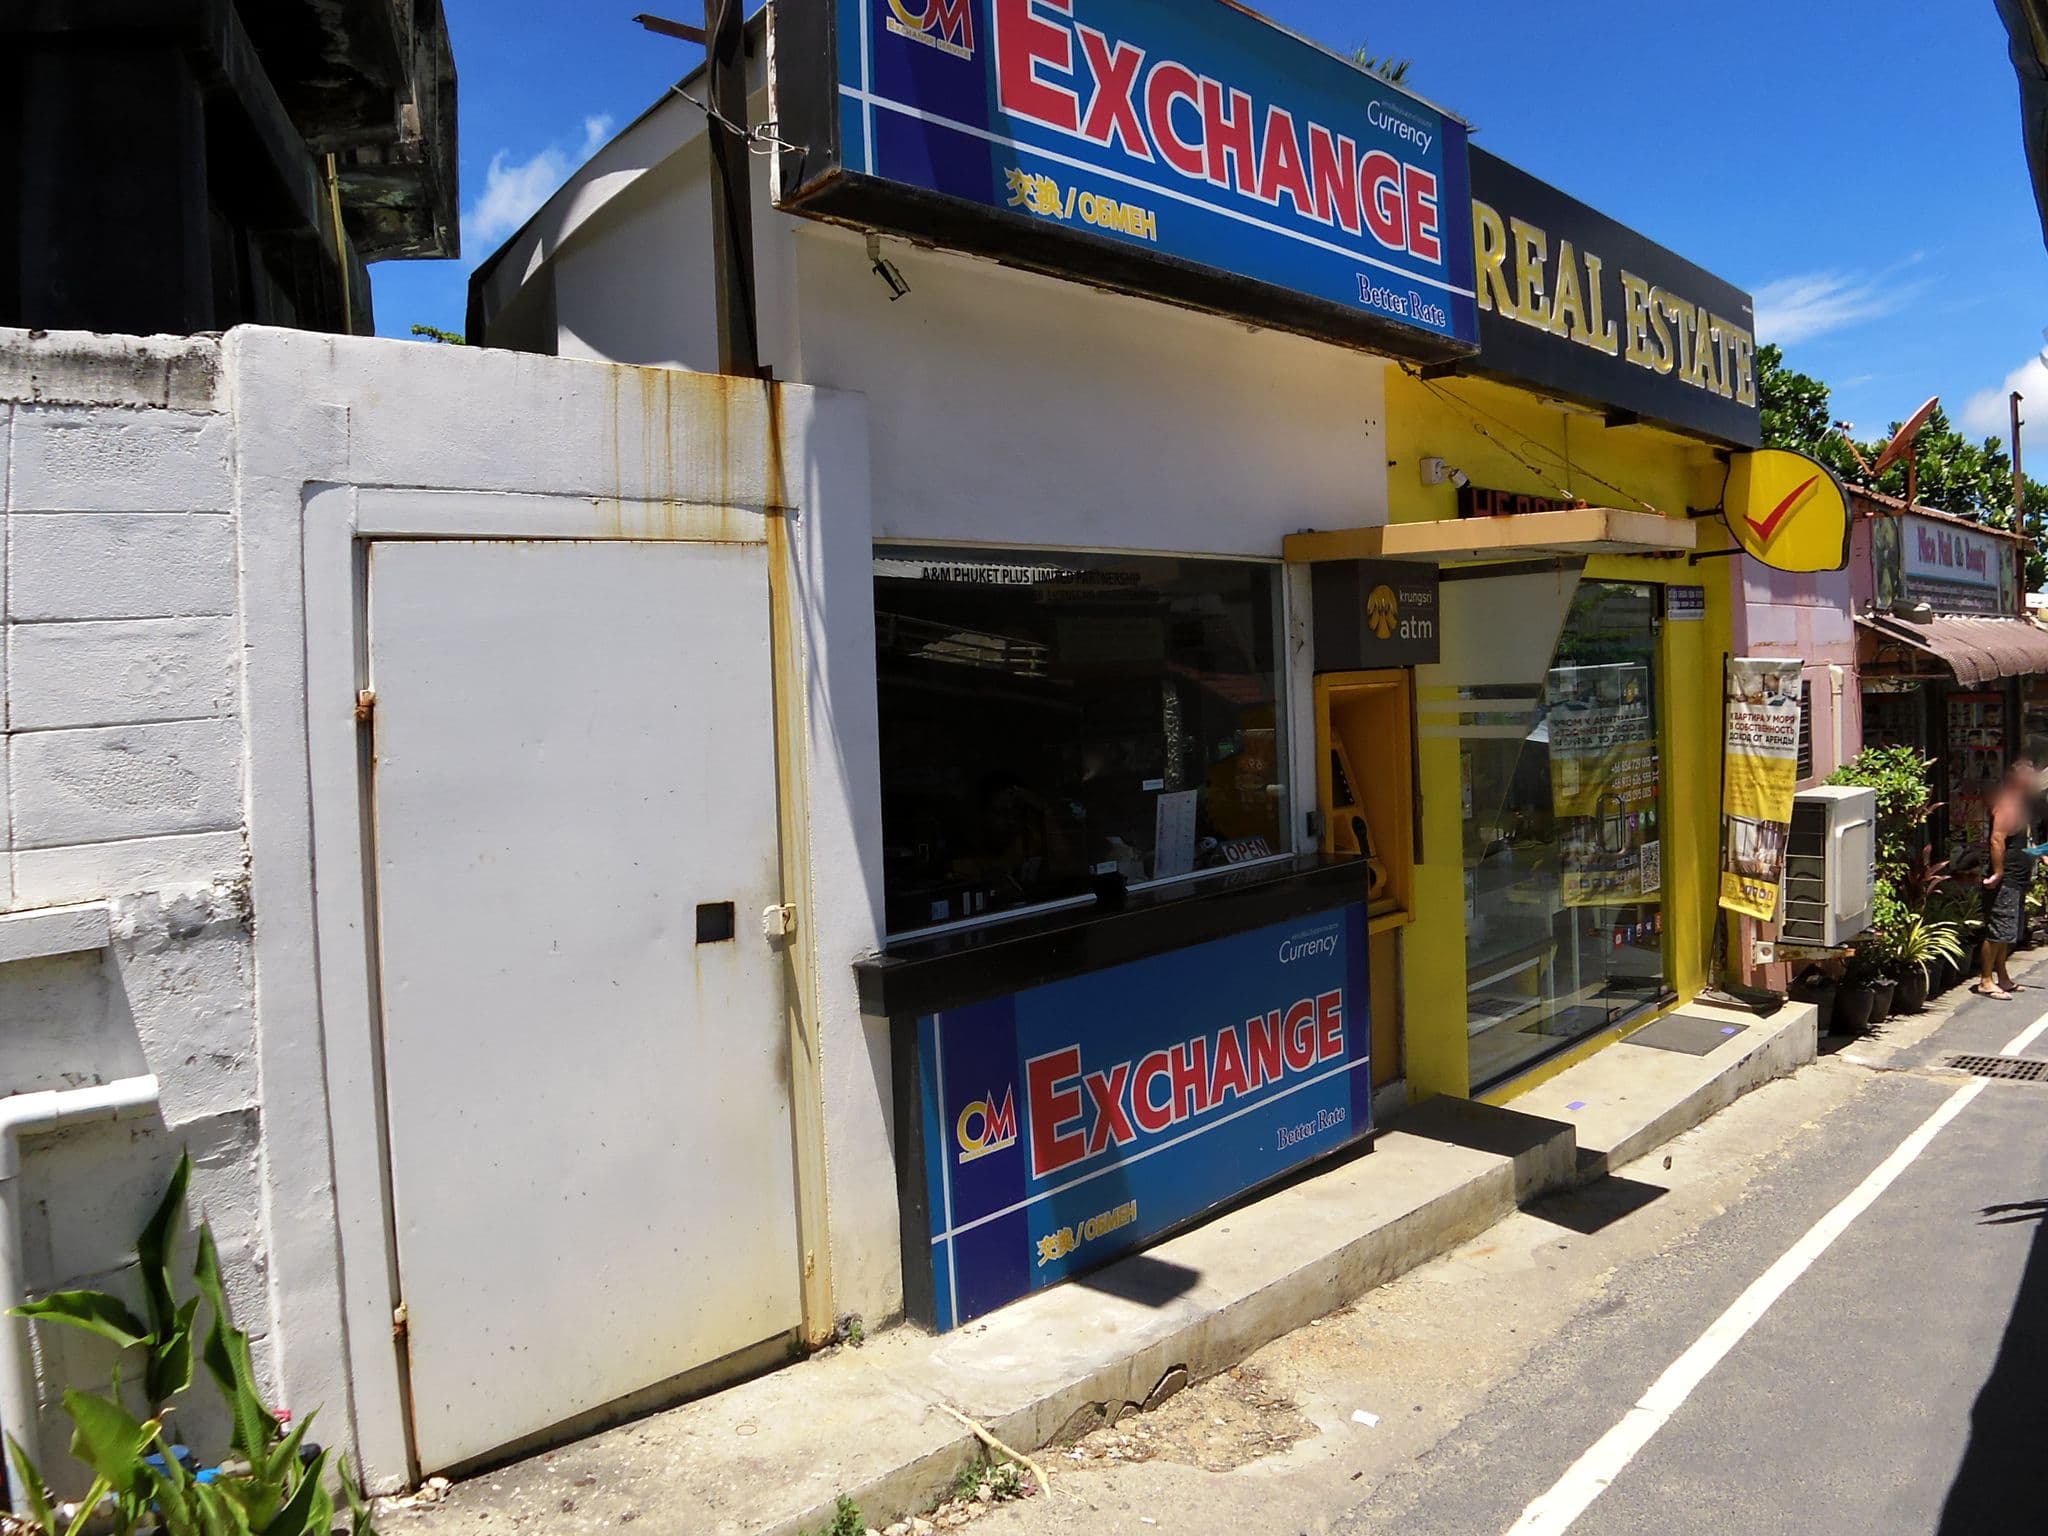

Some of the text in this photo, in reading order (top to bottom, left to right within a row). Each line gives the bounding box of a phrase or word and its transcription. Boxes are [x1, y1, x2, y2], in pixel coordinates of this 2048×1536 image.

[995, 0, 1441, 266] EXCHANGE
[1367, 100, 1432, 155] Currency
[1356, 273, 1446, 327] Better Rate
[1472, 198, 1756, 408] REAL ESTATE
[923, 567, 951, 583] A&M
[953, 567, 1000, 583] PHUKET
[1003, 569, 1030, 583] PLUS
[1033, 569, 1073, 585] LIMITED
[1400, 590, 1432, 605] krungsri
[1400, 616, 1432, 639] atm
[1225, 839, 1270, 862] OPEN
[1279, 934, 1338, 963] Currency
[1025, 988, 1344, 1181] EXCHANGE
[957, 1082, 1017, 1153] OM
[1277, 1107, 1346, 1151] Better Rate
